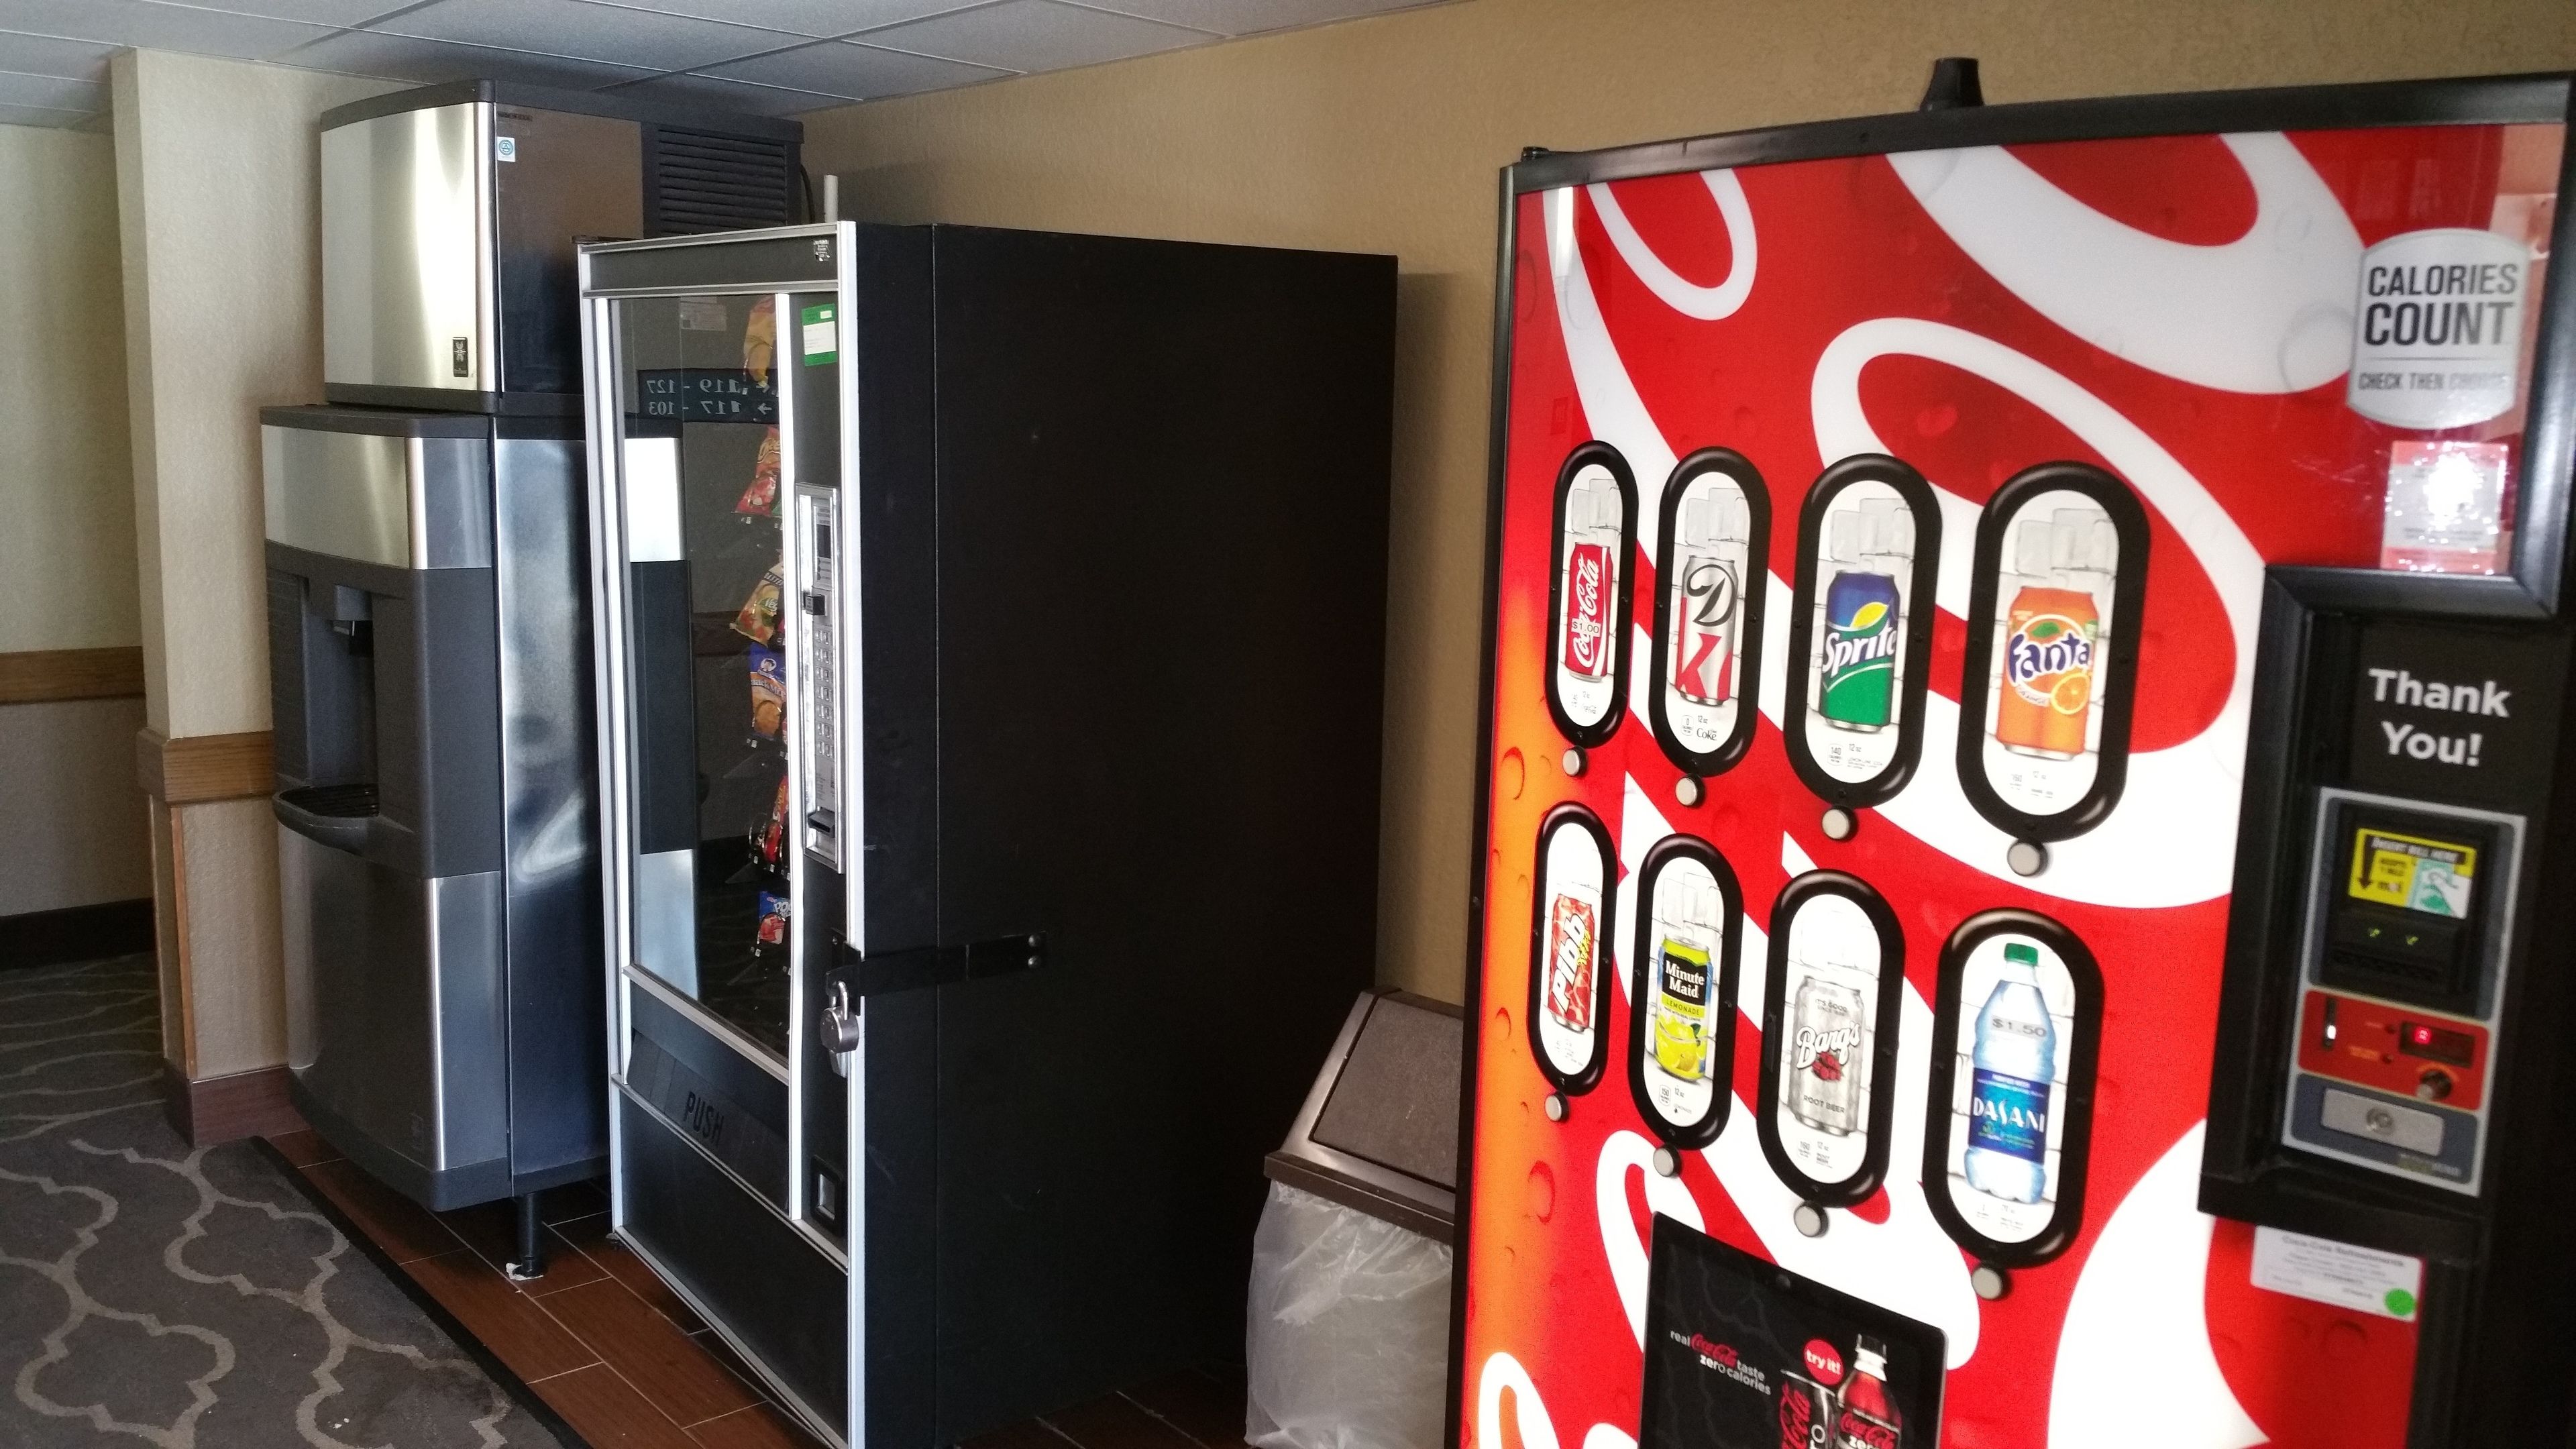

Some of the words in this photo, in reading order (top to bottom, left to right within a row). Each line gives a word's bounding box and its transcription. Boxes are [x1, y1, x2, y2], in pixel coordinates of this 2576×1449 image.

[2368, 263, 2518, 297] CALORIES
[2363, 301, 2514, 346] COUNT
[1572, 621, 1599, 634] $1.00
[1822, 619, 1898, 678] Sprite
[2007, 631, 2091, 684] Fanta
[2368, 668, 2512, 718] Thank
[1697, 727, 1717, 741] Coke
[2381, 720, 2483, 767] You!
[1666, 960, 1705, 985] Minute
[1669, 975, 1699, 998] Maid
[1666, 999, 1700, 1016] LEMONADE
[1796, 1022, 1860, 1069] Barq's
[1992, 1018, 2047, 1038] $1.50
[683, 1091, 724, 1147] PUSH
[1803, 1094, 1824, 1108] ROOT
[1825, 1102, 1845, 1113] BEER
[1973, 1097, 2045, 1134] DASANI
[1670, 1330, 1690, 1348] real
[1736, 1358, 1766, 1382] taste
[1700, 1353, 1726, 1375] zero
[1726, 1367, 1772, 1396] calories
[1805, 1348, 1827, 1370] try
[1827, 1356, 1842, 1376] it!
